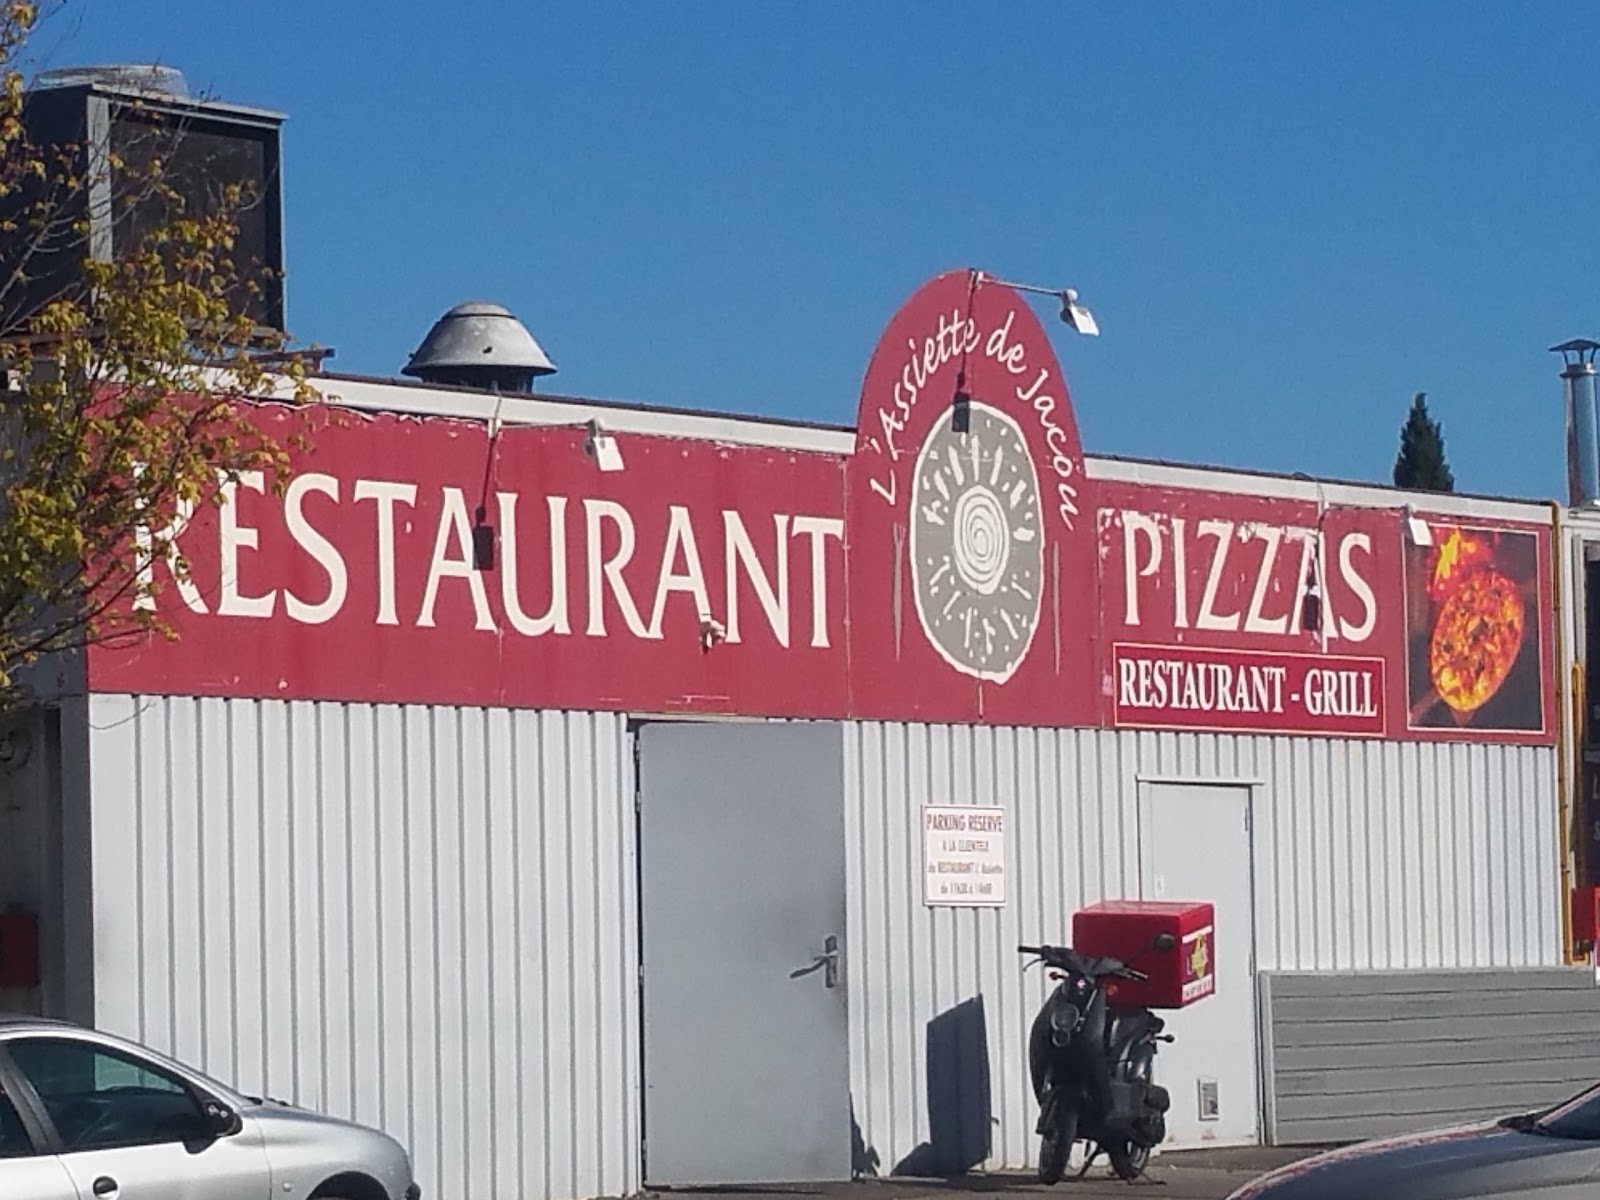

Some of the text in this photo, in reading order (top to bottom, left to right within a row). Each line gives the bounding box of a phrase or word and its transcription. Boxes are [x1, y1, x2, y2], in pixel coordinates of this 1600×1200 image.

[869, 309, 1080, 531] L'Assiette de Jacou
[131, 460, 845, 649] RESTAURANT
[1120, 509, 1377, 642] PIZZAS
[1118, 658, 1287, 713] RESTAURANT
[1304, 668, 1378, 717] GRILL
[926, 814, 965, 831] PARKING
